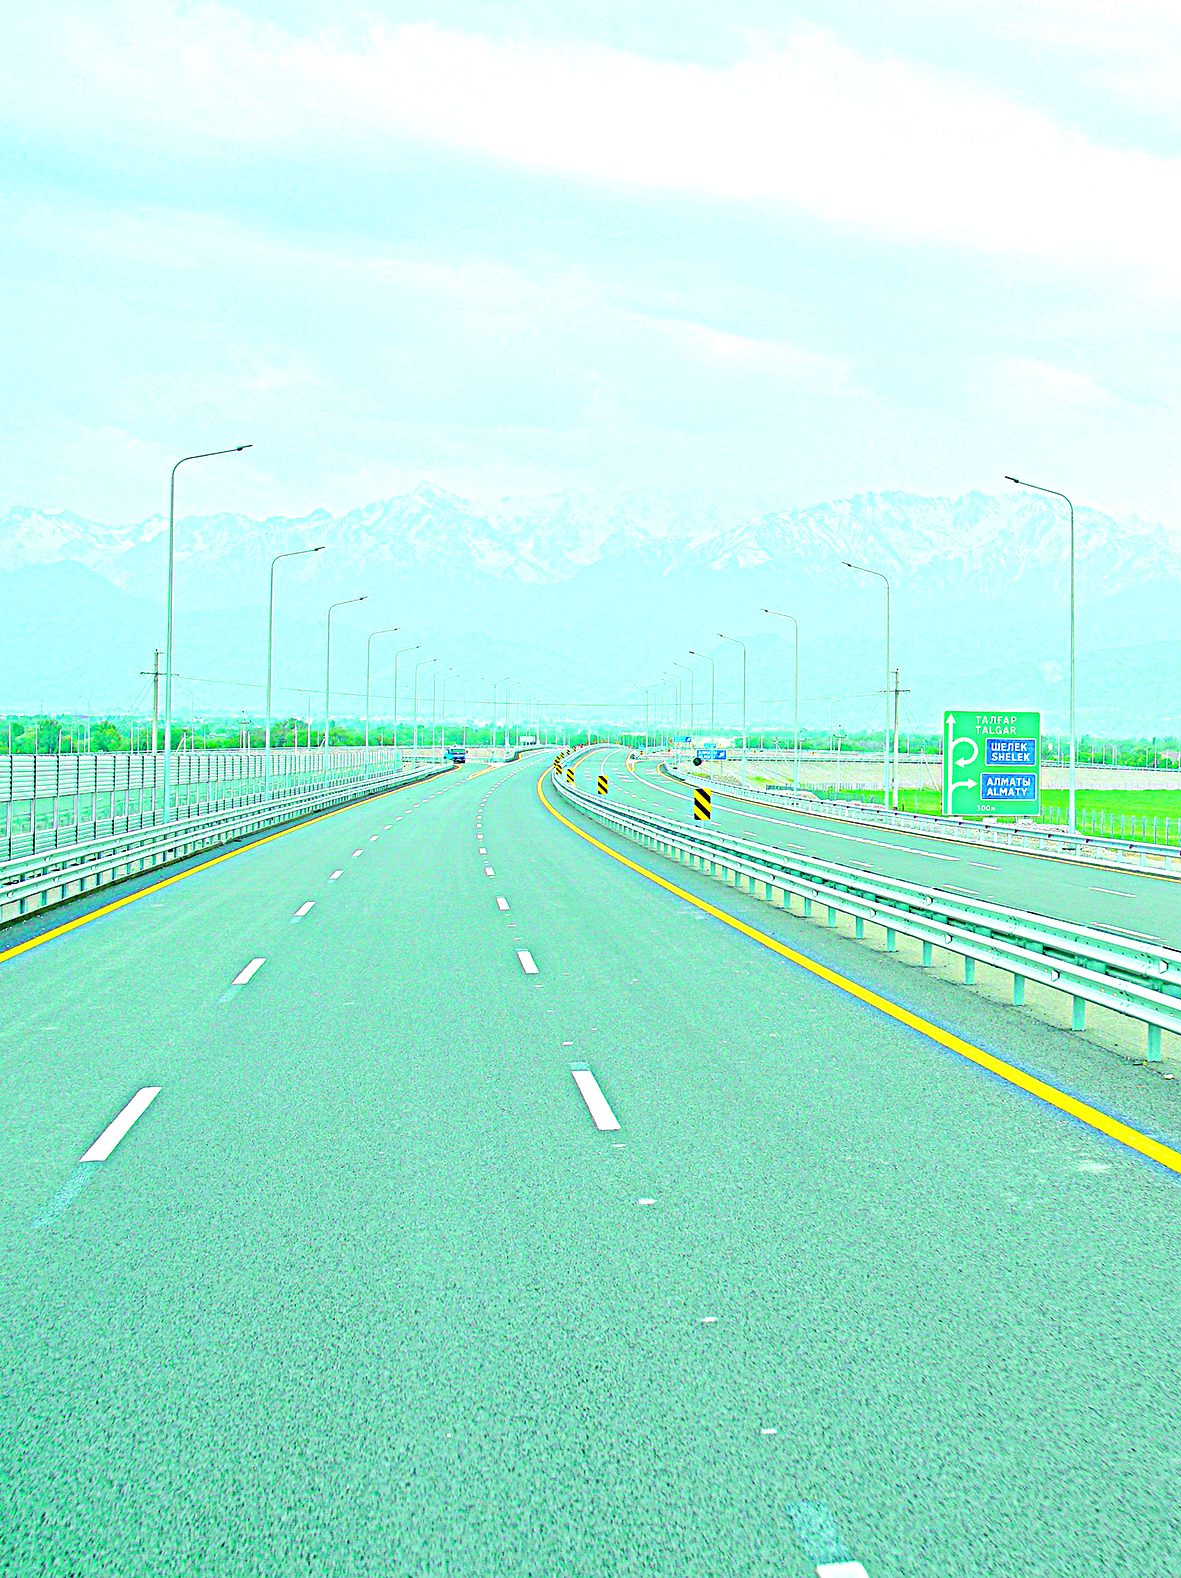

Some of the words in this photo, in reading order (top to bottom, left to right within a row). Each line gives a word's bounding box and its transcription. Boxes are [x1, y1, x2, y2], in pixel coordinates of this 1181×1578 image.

[975, 715, 1017, 725] ТАЛҒАР
[975, 726, 1017, 735] TALGAR
[991, 742, 1028, 752] ШЕЛЕК
[991, 752, 1031, 762] SHELEK
[986, 777, 1031, 786] АЛМАТЫ
[986, 787, 1028, 796] ALMATY
